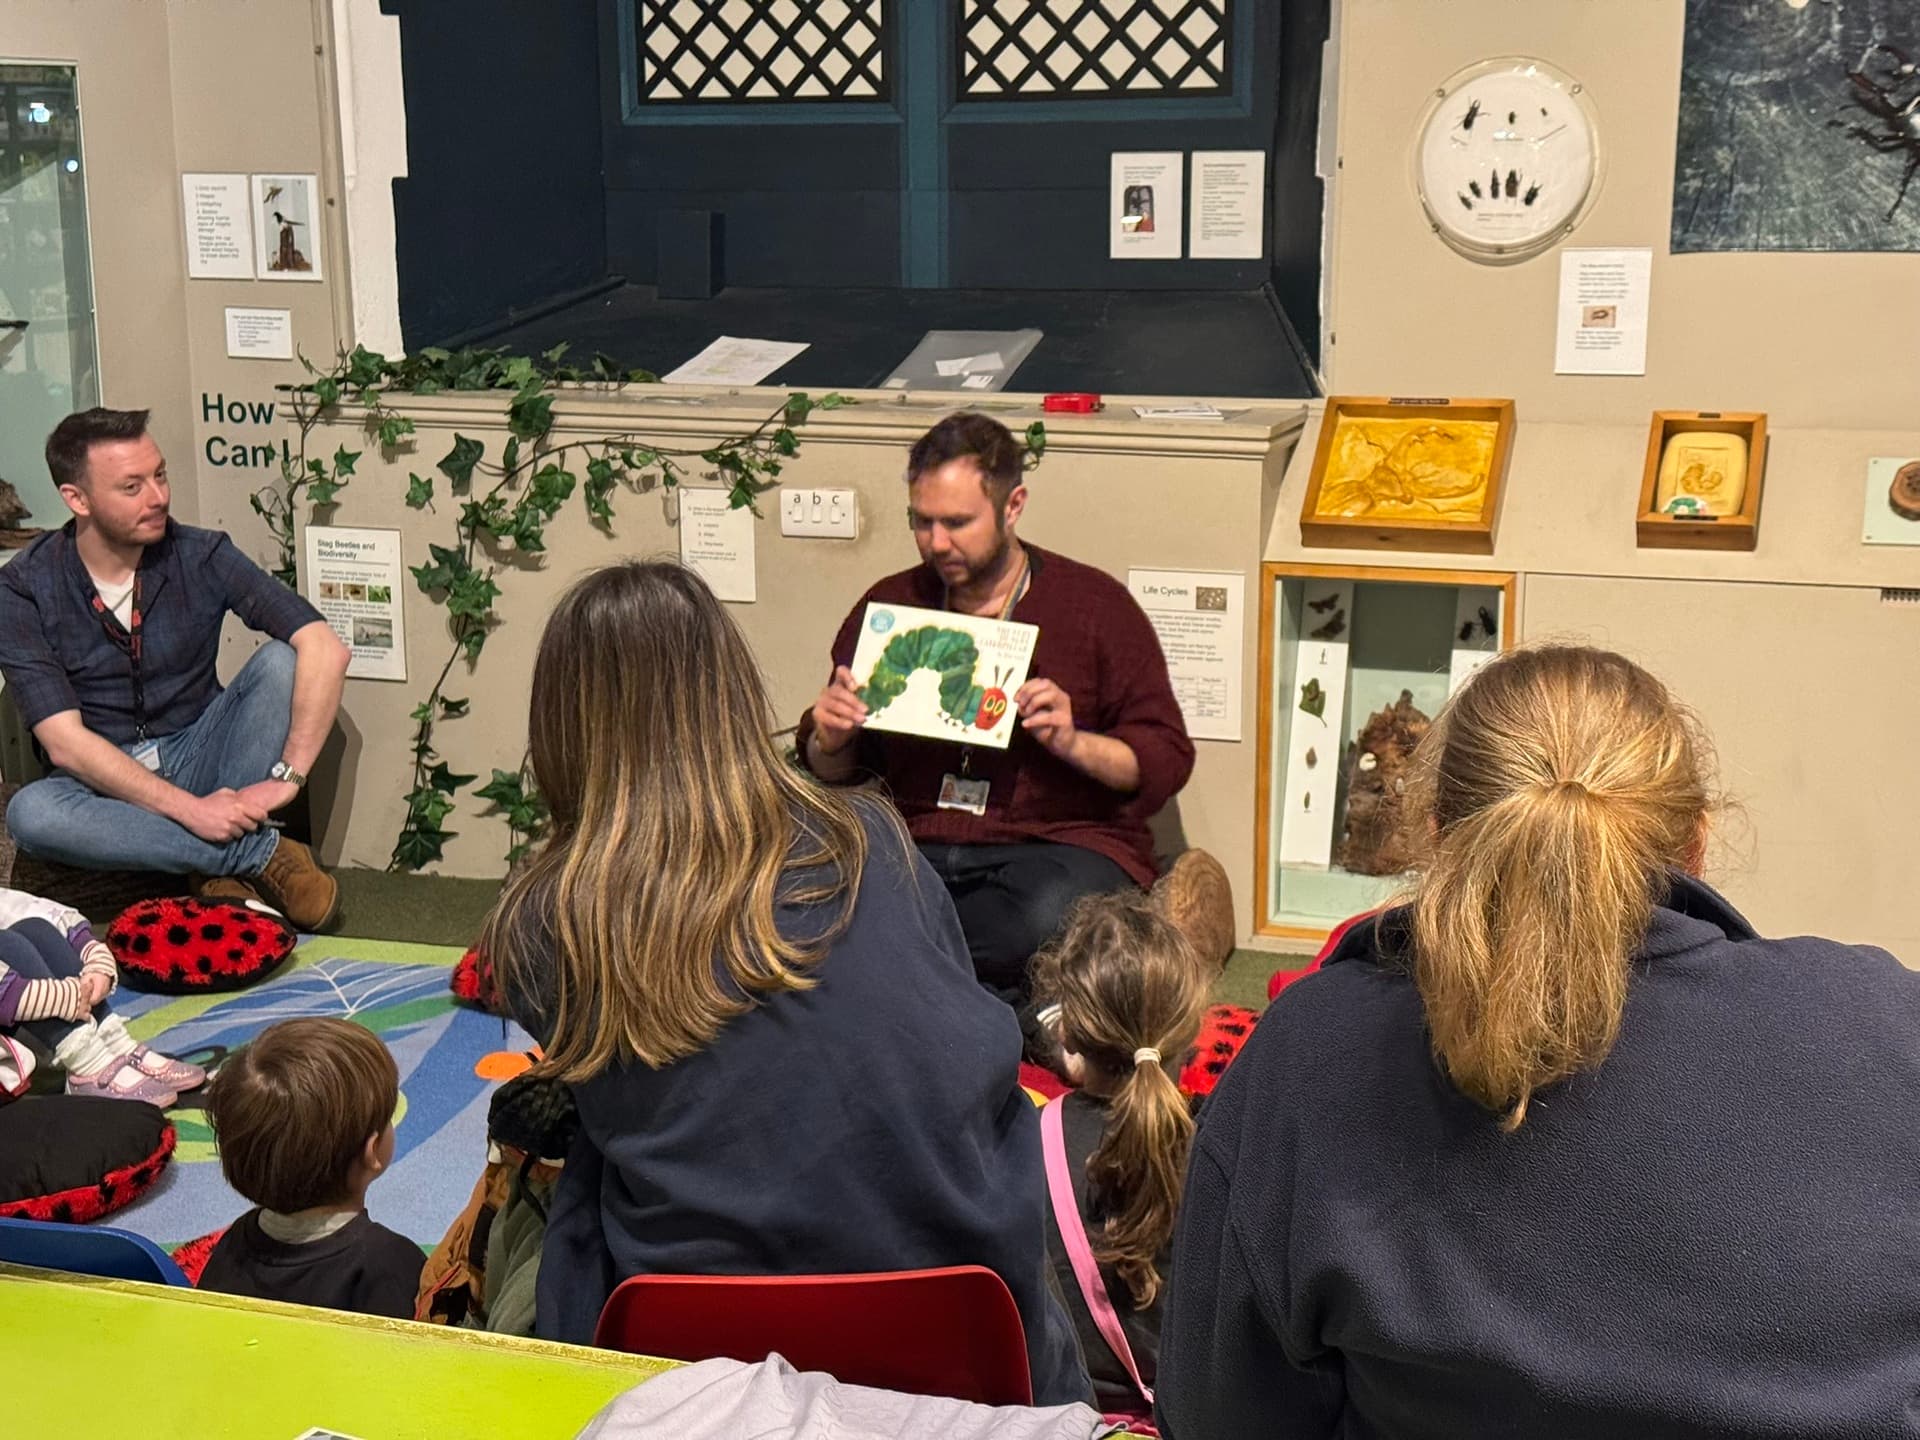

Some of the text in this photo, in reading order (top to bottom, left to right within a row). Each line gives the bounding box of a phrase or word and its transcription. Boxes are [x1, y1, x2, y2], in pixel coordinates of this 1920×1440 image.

[202, 393, 275, 424] How
[205, 436, 270, 468] Can
[793, 492, 840, 505] a b c
[317, 539, 376, 551] Stag Beetles and
[317, 549, 358, 561] Biodiversity
[1142, 585, 1188, 597] Life Cycles
